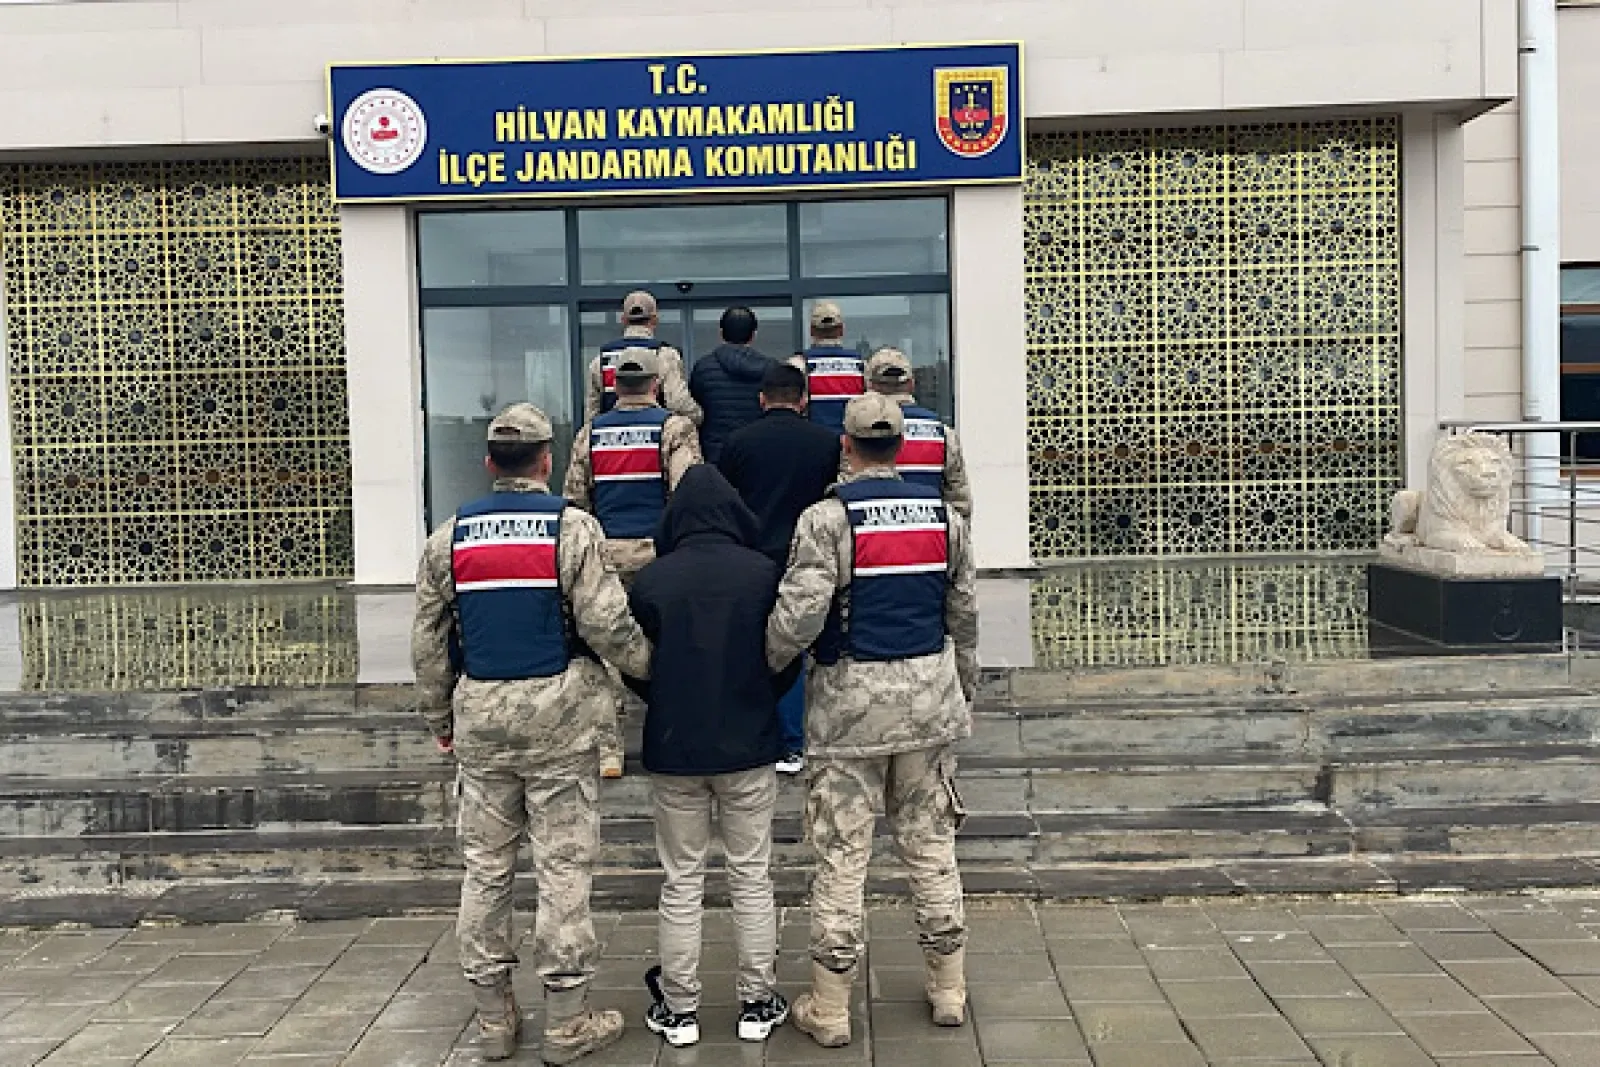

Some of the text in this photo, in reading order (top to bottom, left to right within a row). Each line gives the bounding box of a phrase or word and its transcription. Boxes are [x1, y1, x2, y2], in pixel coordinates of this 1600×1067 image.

[647, 63, 708, 95] T.C.
[495, 95, 855, 142] HİLVAN KAYMAKAMLIĞI
[438, 133, 917, 188] İLÇE JANDARMA KOMUTANLIĞI
[464, 519, 548, 541] JANDARMA
[863, 504, 938, 526] JANDARMA
